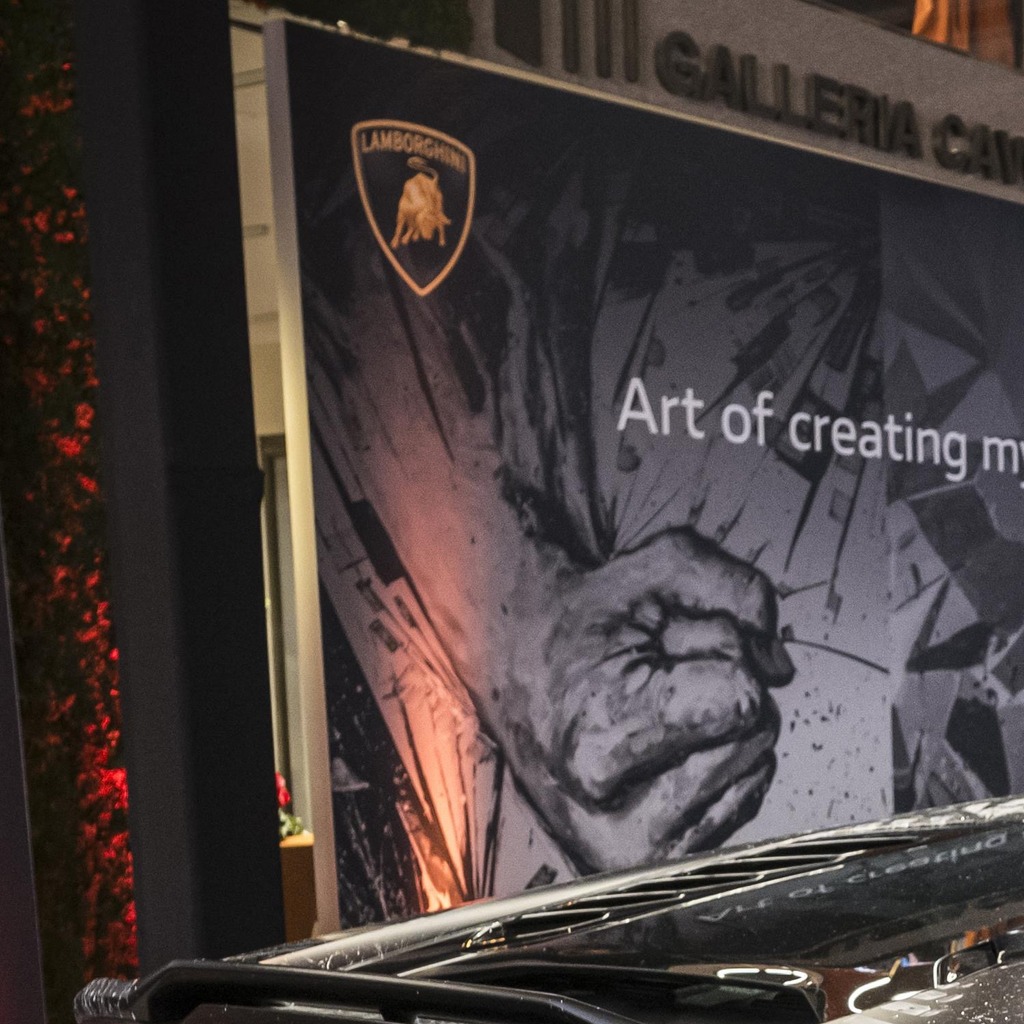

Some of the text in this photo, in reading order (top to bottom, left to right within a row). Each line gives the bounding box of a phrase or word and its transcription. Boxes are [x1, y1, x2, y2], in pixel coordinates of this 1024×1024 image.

[654, 30, 923, 159] GALLERIA
[617, 377, 705, 439] Art
[721, 391, 774, 446] of
[788, 412, 967, 482] creating
